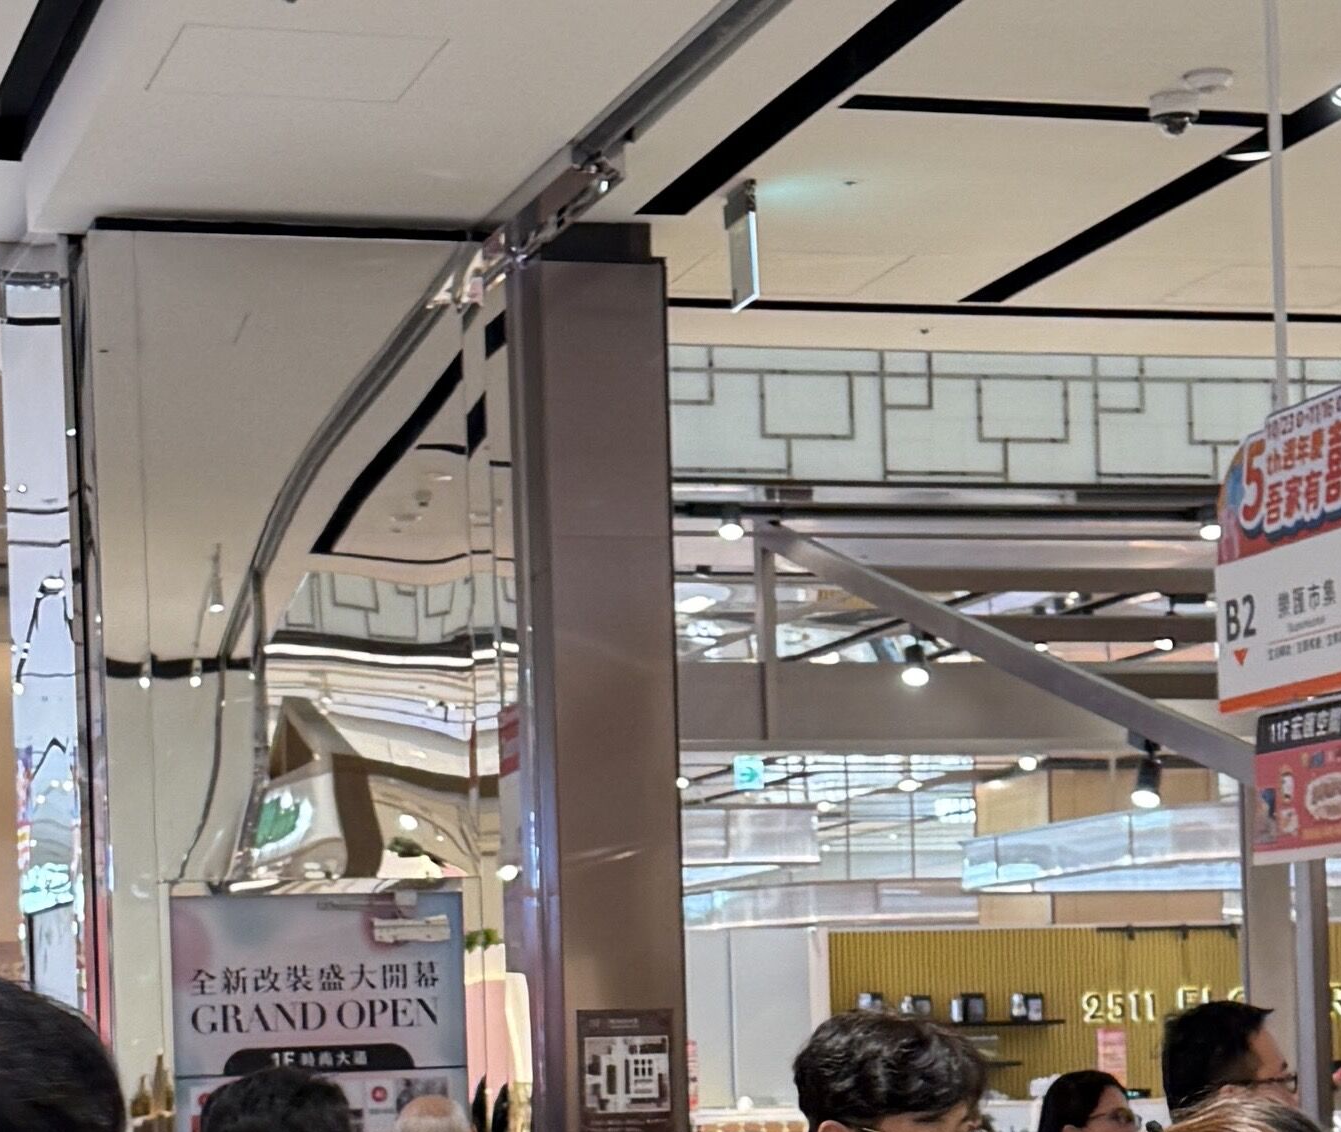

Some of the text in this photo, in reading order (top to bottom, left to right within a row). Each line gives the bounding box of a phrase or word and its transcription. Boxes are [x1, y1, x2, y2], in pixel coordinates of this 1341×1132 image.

[1226, 594, 1257, 642] B2
[190, 961, 441, 997] 全新改裝盛大開幕
[191, 997, 440, 1034] GRAND OPEN
[1082, 990, 1156, 1023] 2511
[270, 1051, 295, 1067] 1F
